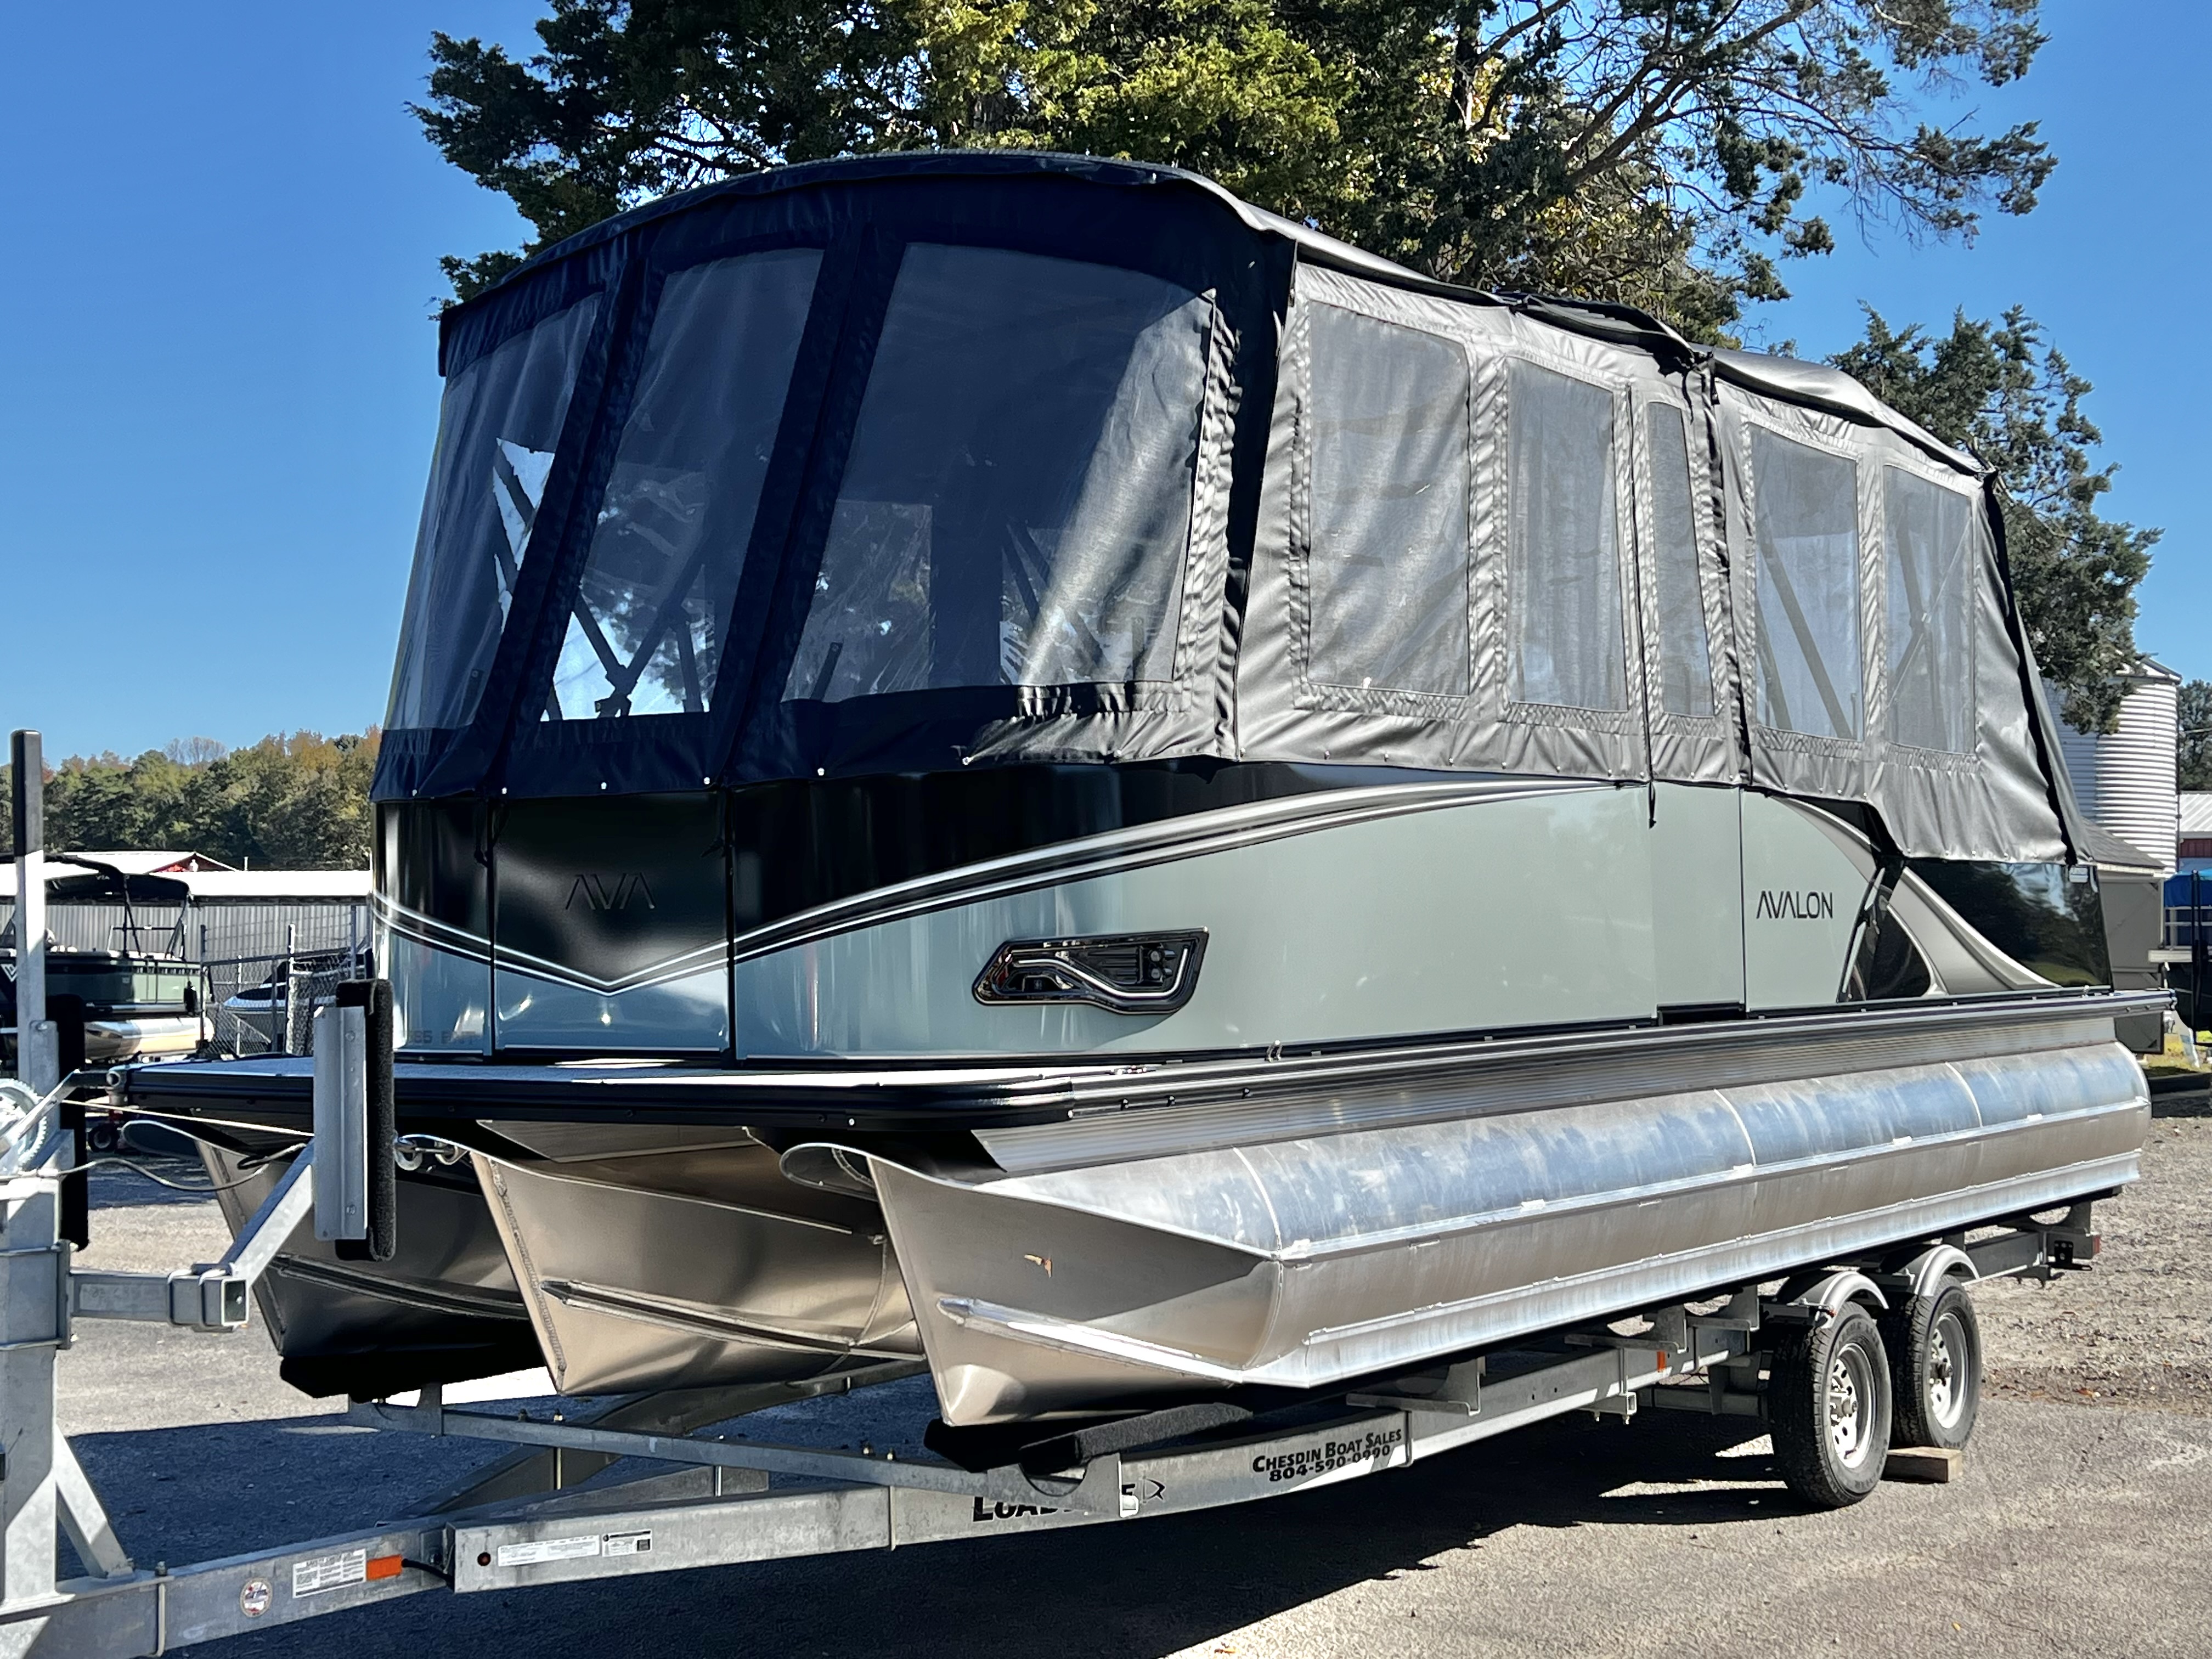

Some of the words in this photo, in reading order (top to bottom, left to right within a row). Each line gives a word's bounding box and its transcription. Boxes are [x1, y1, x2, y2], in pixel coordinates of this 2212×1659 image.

[566, 872, 655, 910] AVA
[1756, 890, 1833, 919] AVALON
[1252, 1448, 1321, 1472] CHESDIN
[1325, 1438, 1362, 1459] BOAT
[1365, 1429, 1402, 1449] SALES
